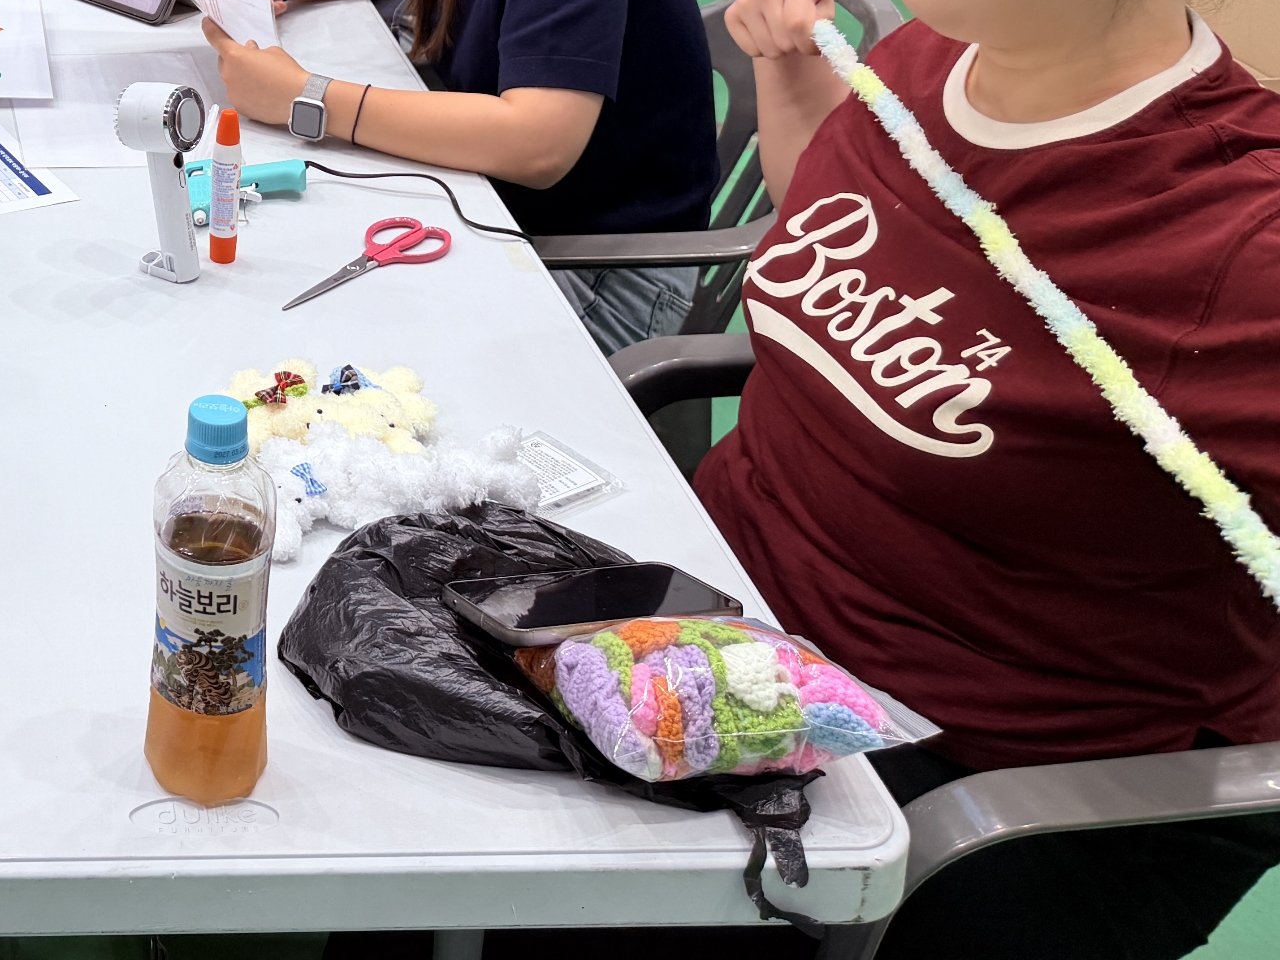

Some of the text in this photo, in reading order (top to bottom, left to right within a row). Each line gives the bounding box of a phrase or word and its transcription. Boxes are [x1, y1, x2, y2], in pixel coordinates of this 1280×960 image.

[742, 192, 995, 442] Boston
[960, 327, 1012, 371] 74
[160, 570, 238, 615] 하늘보리
